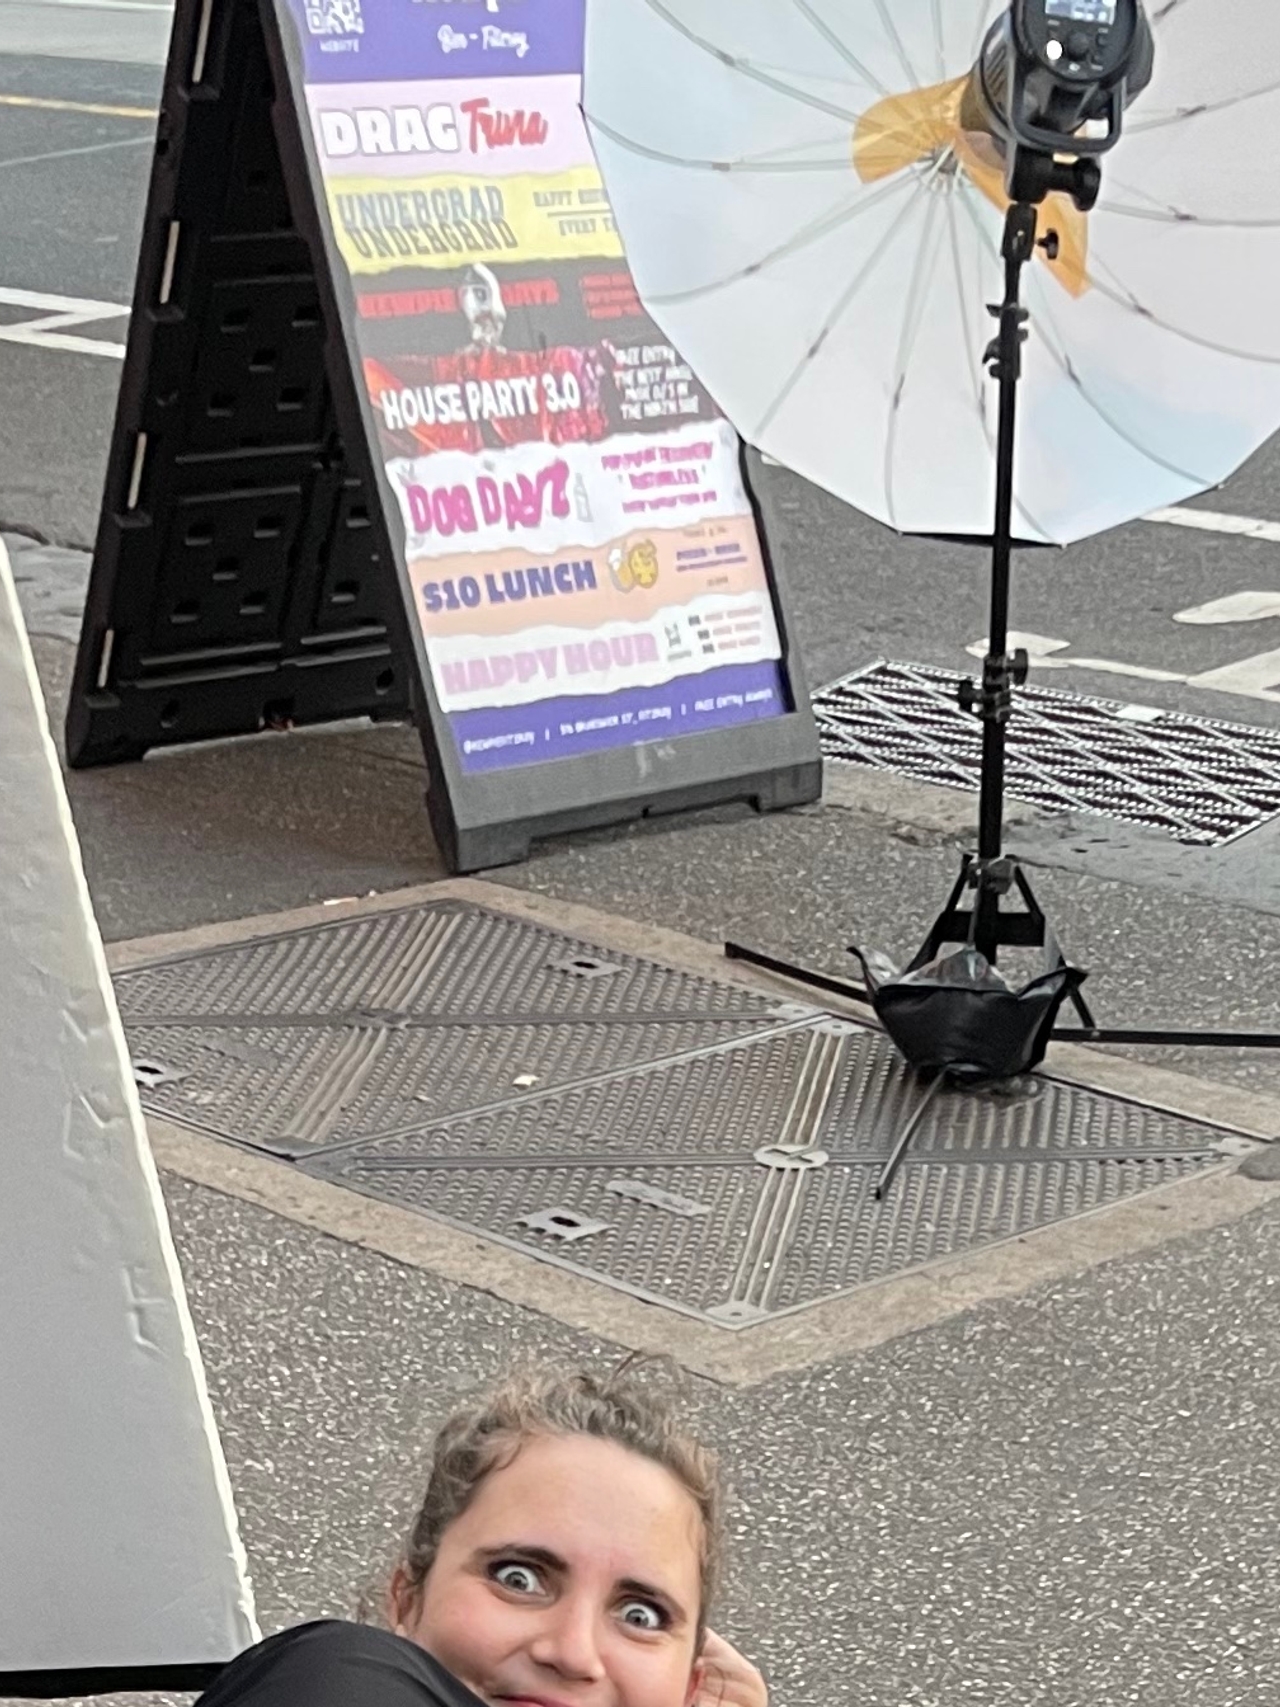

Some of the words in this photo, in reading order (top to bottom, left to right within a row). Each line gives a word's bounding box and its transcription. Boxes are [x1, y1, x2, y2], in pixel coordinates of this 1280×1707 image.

[319, 102, 461, 158] DRAG
[380, 382, 467, 430] HOUSE
[465, 375, 539, 422] PARTY
[542, 371, 581, 413] 3.0
[484, 559, 598, 604] LUNCH
[440, 646, 558, 696] HAPPY
[563, 632, 659, 676] HOUR
